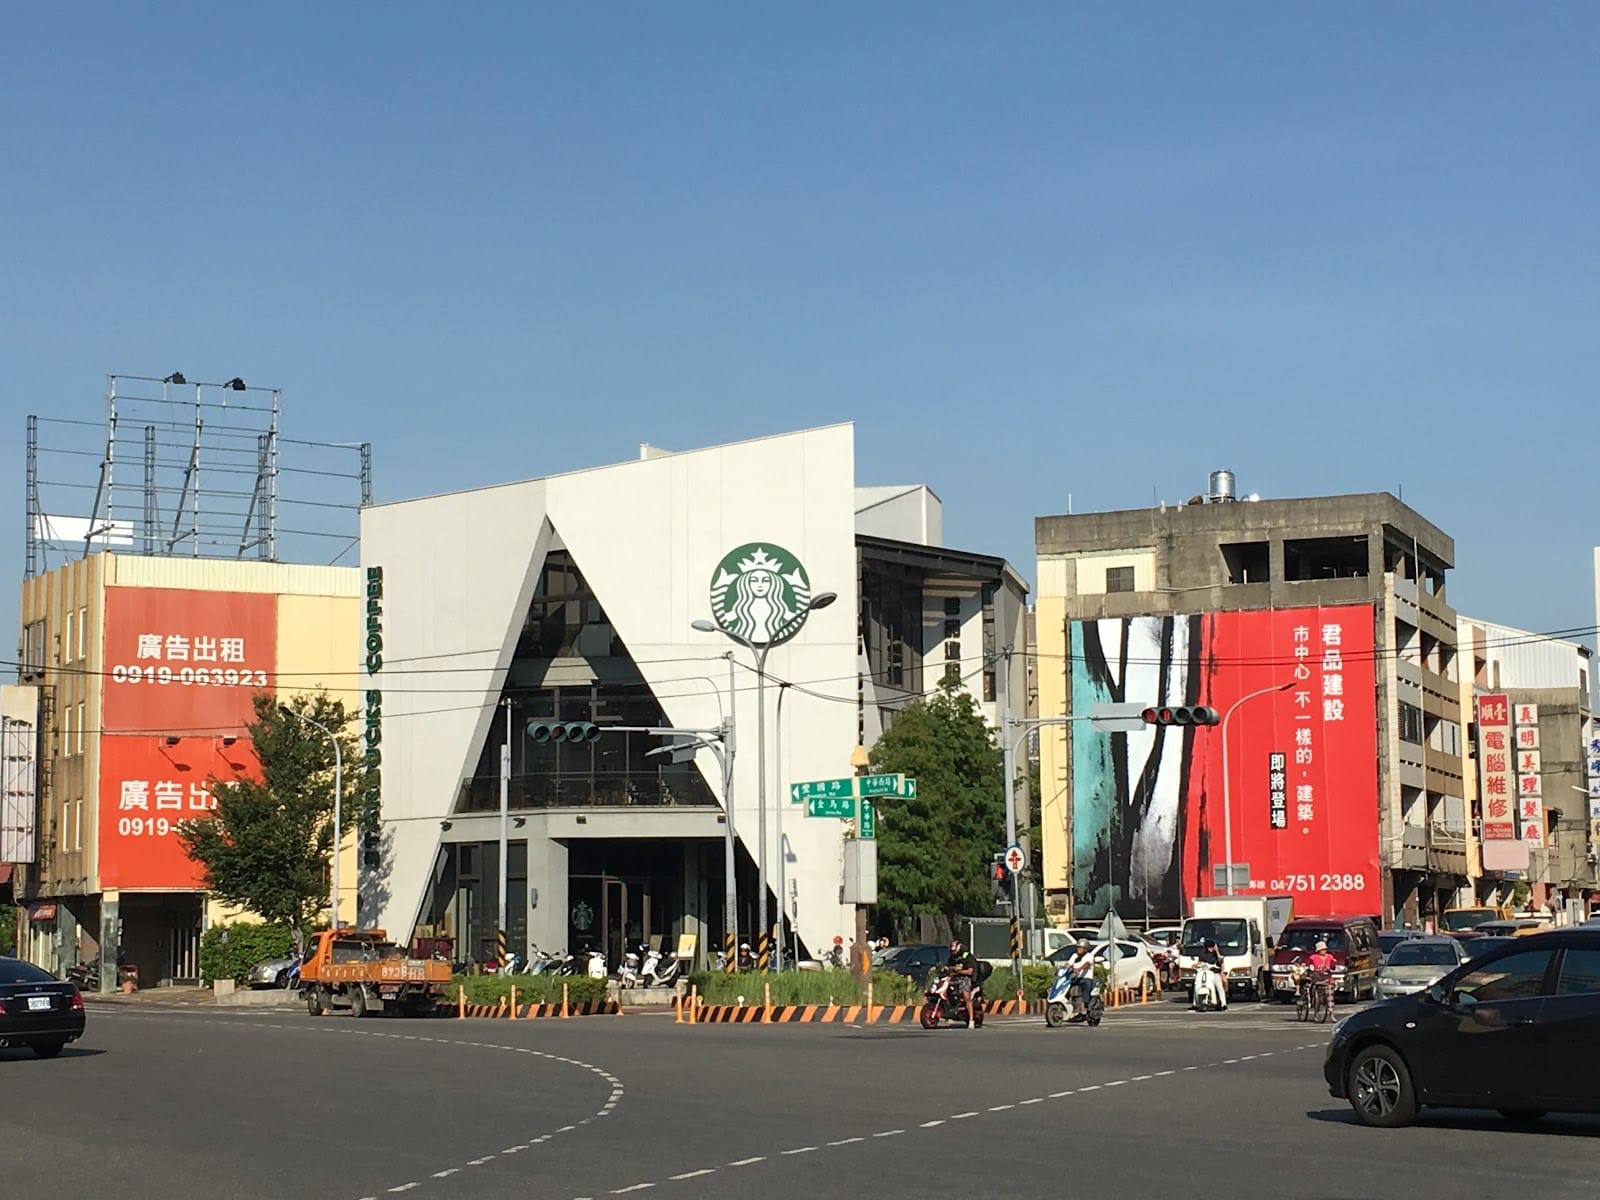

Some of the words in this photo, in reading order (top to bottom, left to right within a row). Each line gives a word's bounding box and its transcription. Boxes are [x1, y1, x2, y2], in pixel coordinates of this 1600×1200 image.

[136, 634, 246, 663] 廣告出租
[366, 566, 383, 677] COFFEE
[112, 665, 269, 688] 0919-063923
[1322, 623, 1345, 721] 君品建設
[118, 780, 241, 812] 廣告出
[1271, 754, 1287, 828] 即將登場
[1485, 731, 1508, 818] 電腦維修
